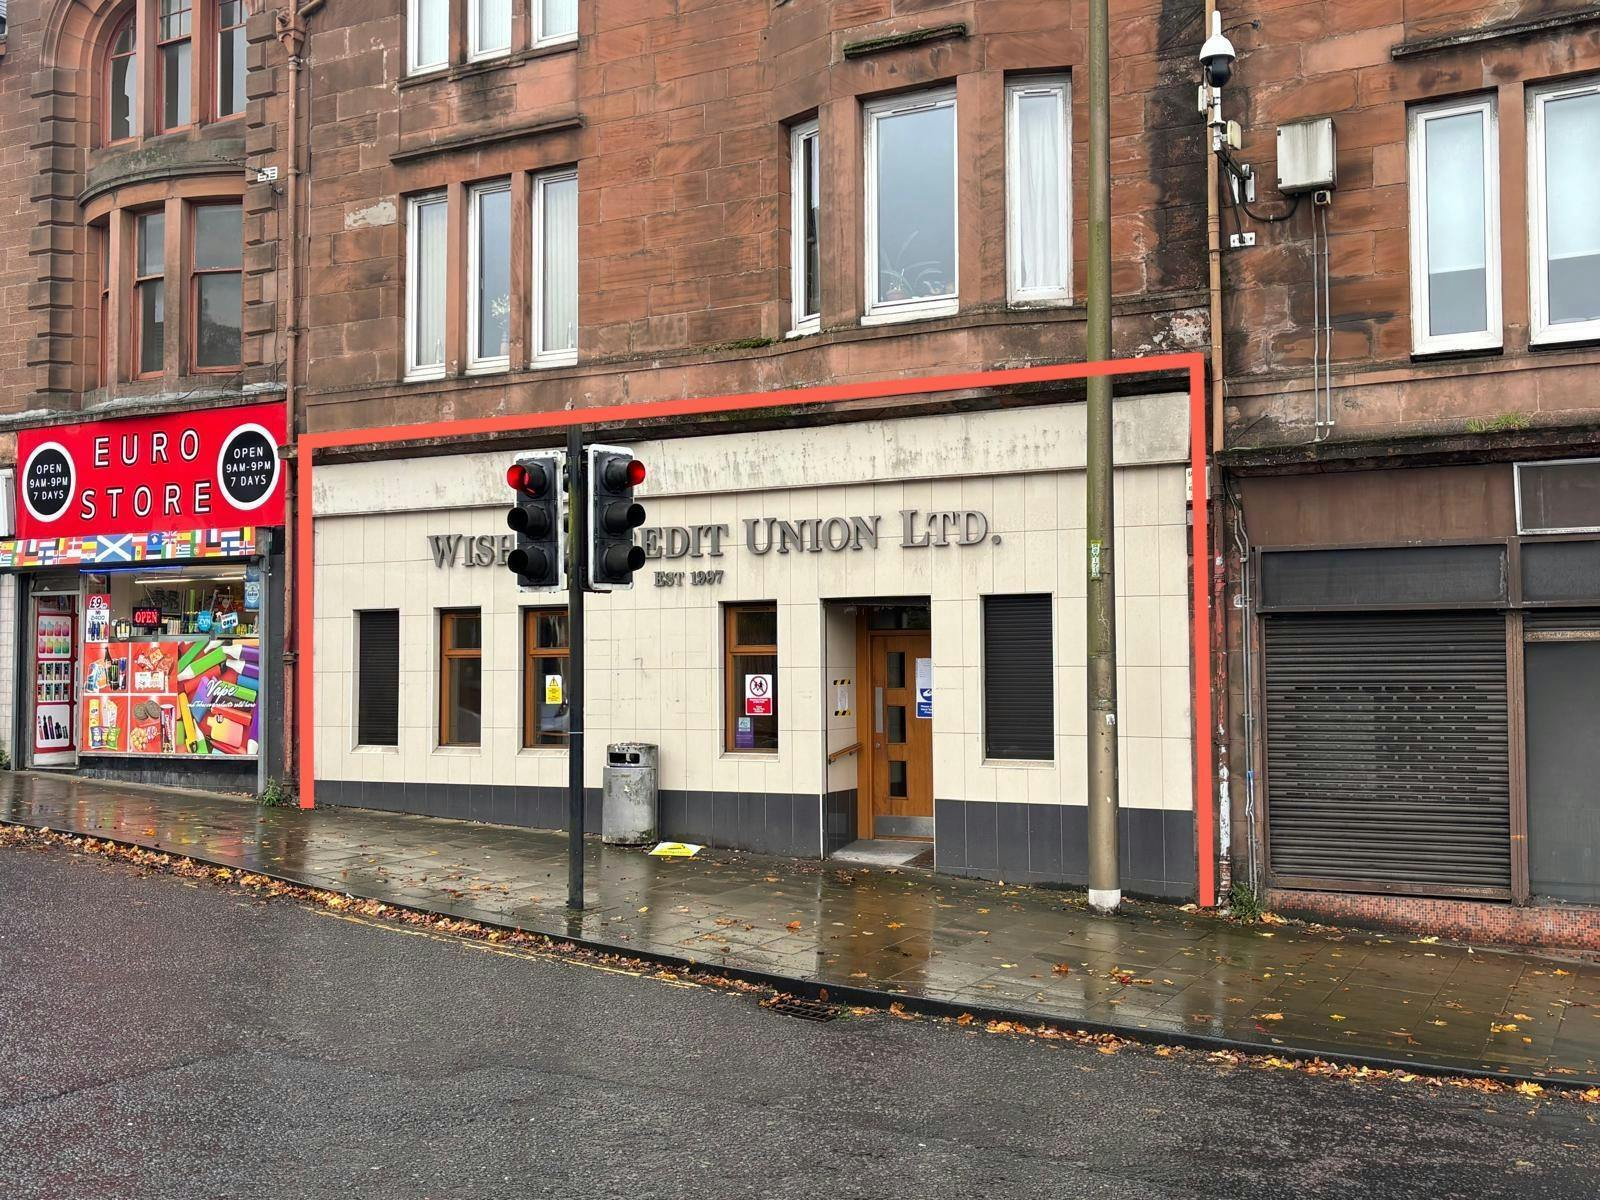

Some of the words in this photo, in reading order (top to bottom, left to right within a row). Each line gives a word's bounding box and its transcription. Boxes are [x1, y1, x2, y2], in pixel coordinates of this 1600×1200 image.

[94, 428, 200, 468] EURO
[233, 446, 264, 459] OPEN
[36, 463, 62, 475] OPEN
[226, 460, 271, 473] 9AM-9PM
[29, 476, 68, 489] 9AM-9PM
[230, 476, 237, 488] 7
[240, 474, 267, 487] DAYS
[33, 491, 39, 501] 7
[41, 489, 64, 500] DAYS
[80, 480, 212, 521] STORE
[426, 533, 516, 569] WISH
[634, 523, 730, 559] EDIT
[742, 515, 882, 555] UNION
[899, 509, 1002, 548] LTD.
[654, 570, 685, 587] EST
[689, 569, 725, 586] 1997
[134, 611, 158, 624] OPEN
[222, 618, 237, 627] OPEN
[206, 680, 238, 703] Vape
